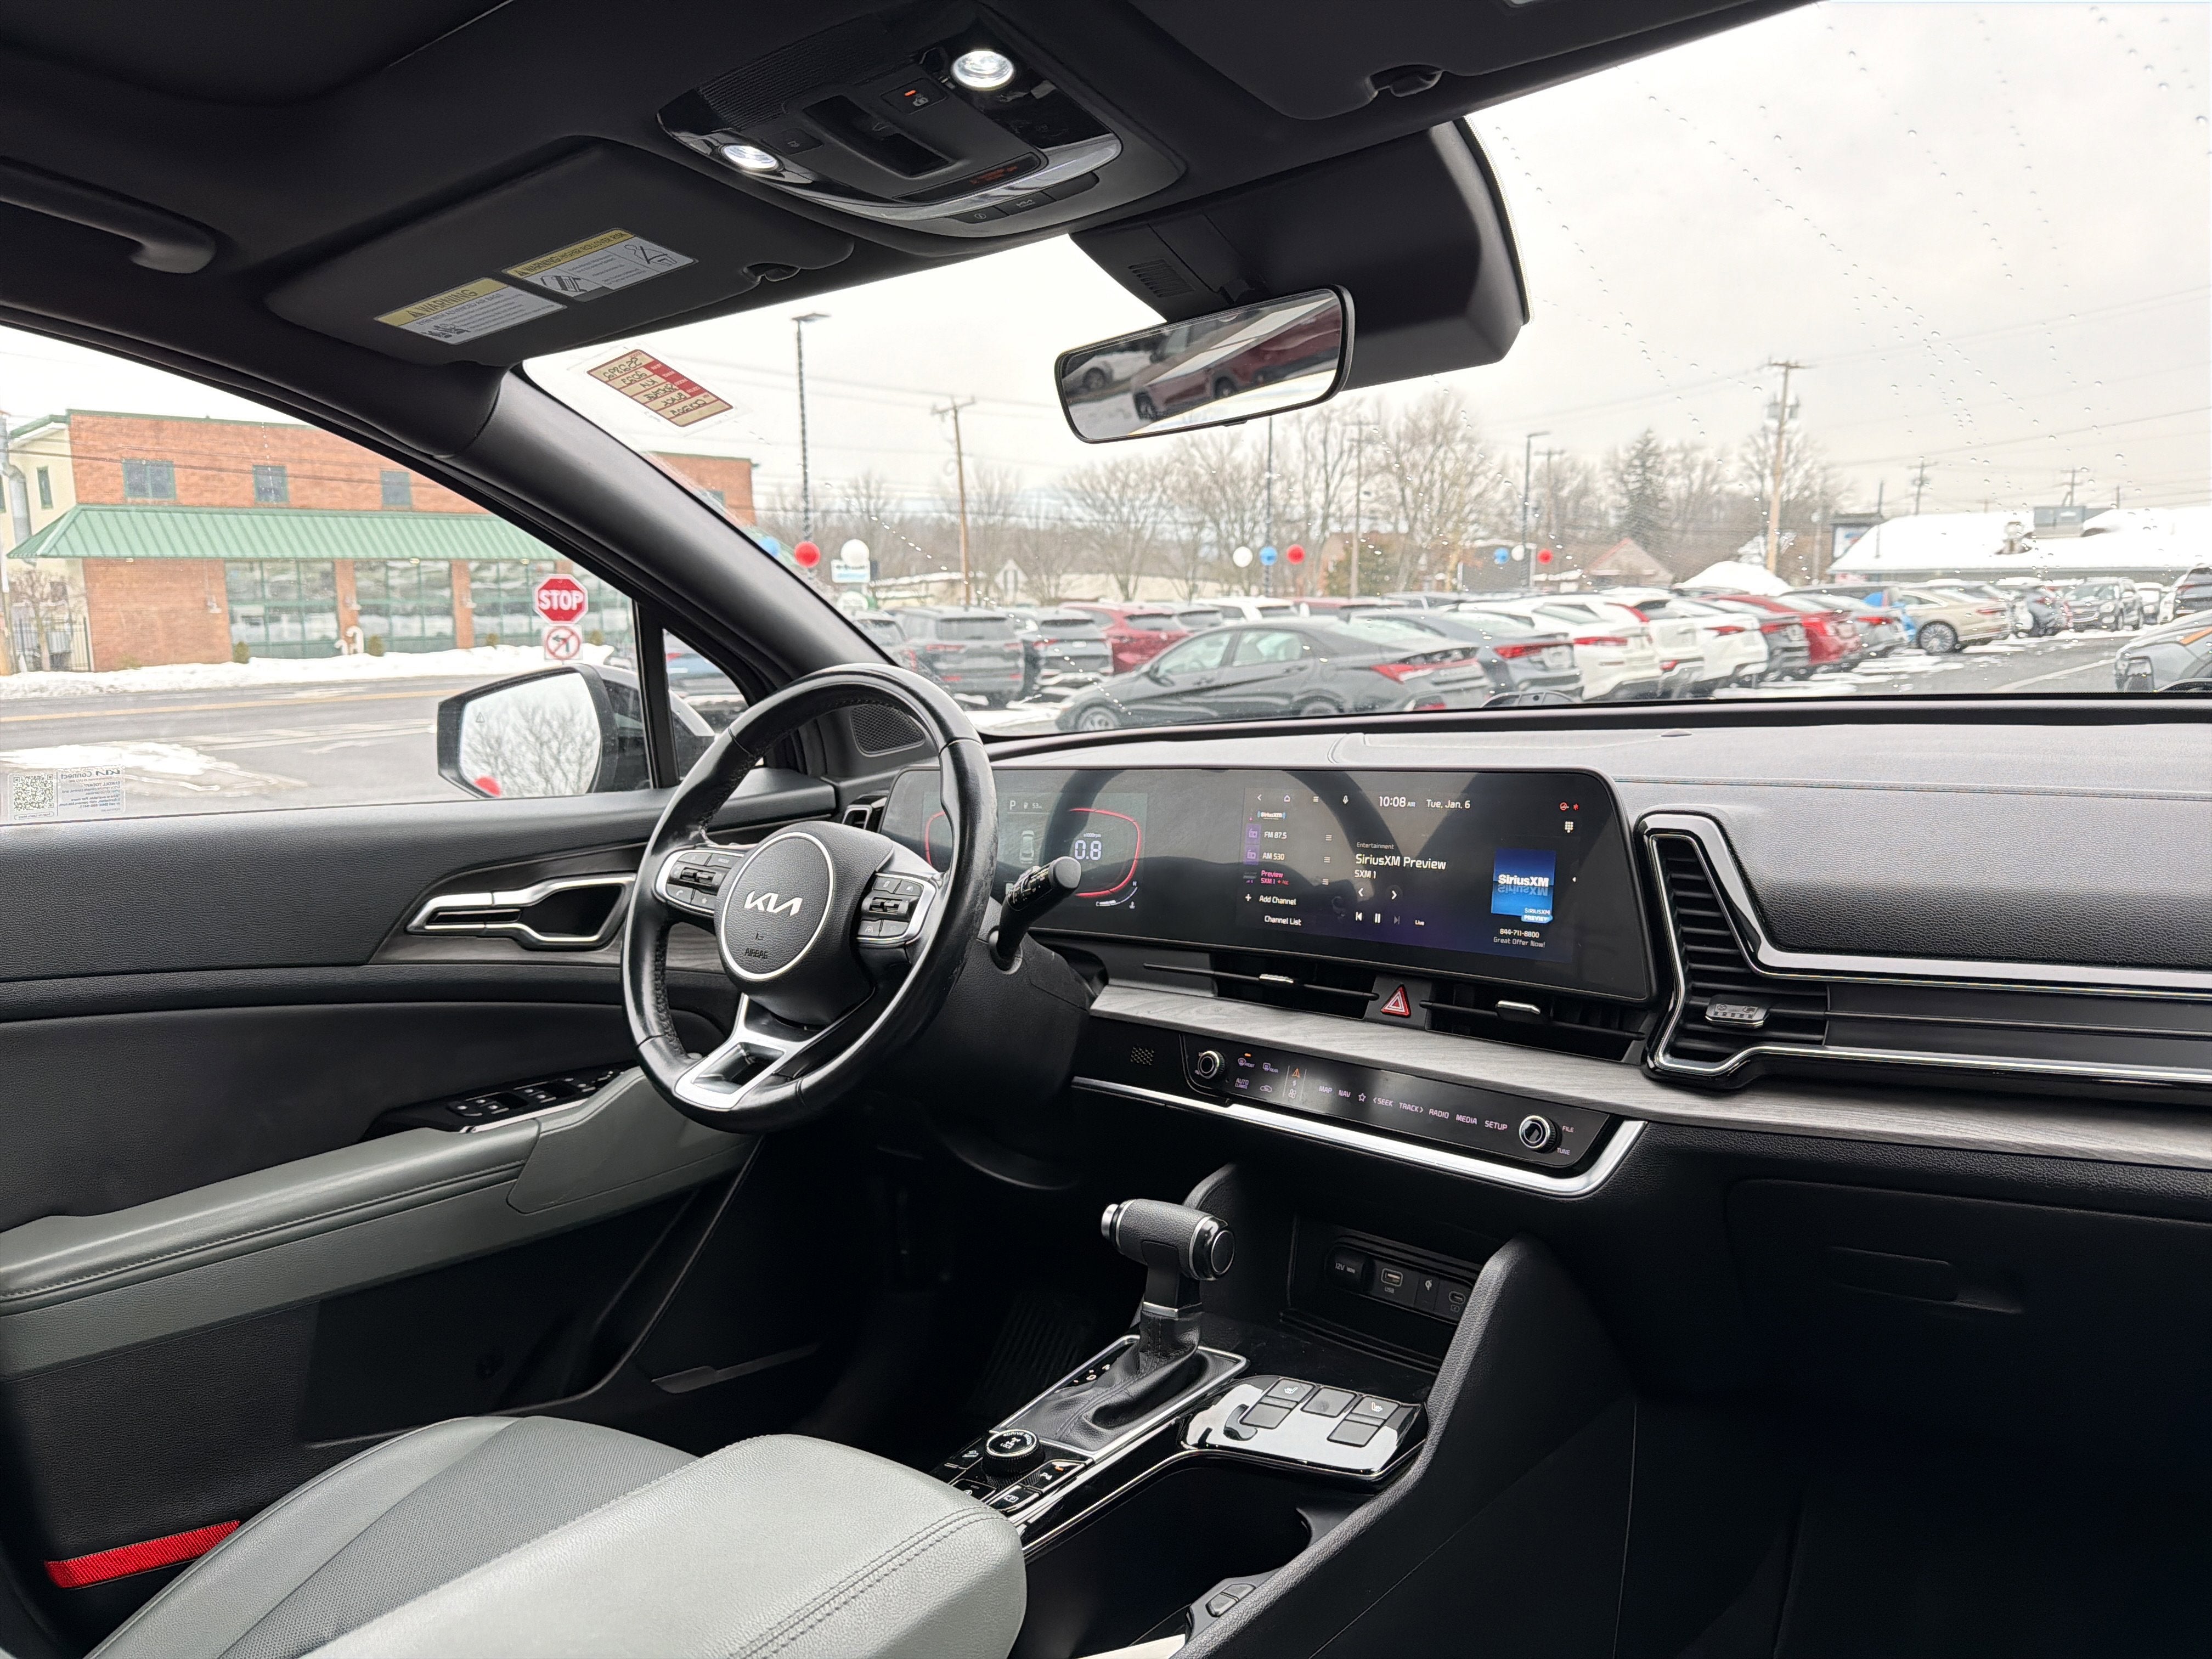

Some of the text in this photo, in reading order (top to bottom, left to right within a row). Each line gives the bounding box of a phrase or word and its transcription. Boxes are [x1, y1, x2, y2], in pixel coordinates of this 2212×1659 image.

[418, 289, 478, 314] WARNING
[539, 589, 584, 611] STOP
[1009, 800, 1016, 810] P
[1379, 796, 1406, 808] 10:08
[1445, 800, 1463, 809] Jan.
[1464, 800, 1471, 809] 6
[1074, 840, 1102, 861] 0.8
[1356, 842, 1395, 850] Entertainment
[1355, 854, 1447, 870] SiriusXM Preview
[1261, 870, 1284, 878] Preview
[1354, 870, 1376, 879] SXM 1
[1498, 874, 1549, 887] SiriusXM
[743, 890, 803, 917] KIA
[1259, 895, 1296, 905] Add Channel
[1264, 915, 1302, 926] Channel List
[1499, 928, 1540, 938] 844-711-8800
[1530, 940, 1545, 948] Now!
[744, 947, 769, 959] AIRBAG
[1318, 1085, 1333, 1094] MAP
[1338, 1090, 1351, 1098] NAV
[1429, 1108, 1449, 1119] RADIO
[1455, 1114, 1477, 1125] MEDIA
[1485, 1120, 1508, 1131] SETUP
[1556, 1147, 1570, 1155] TUNE
